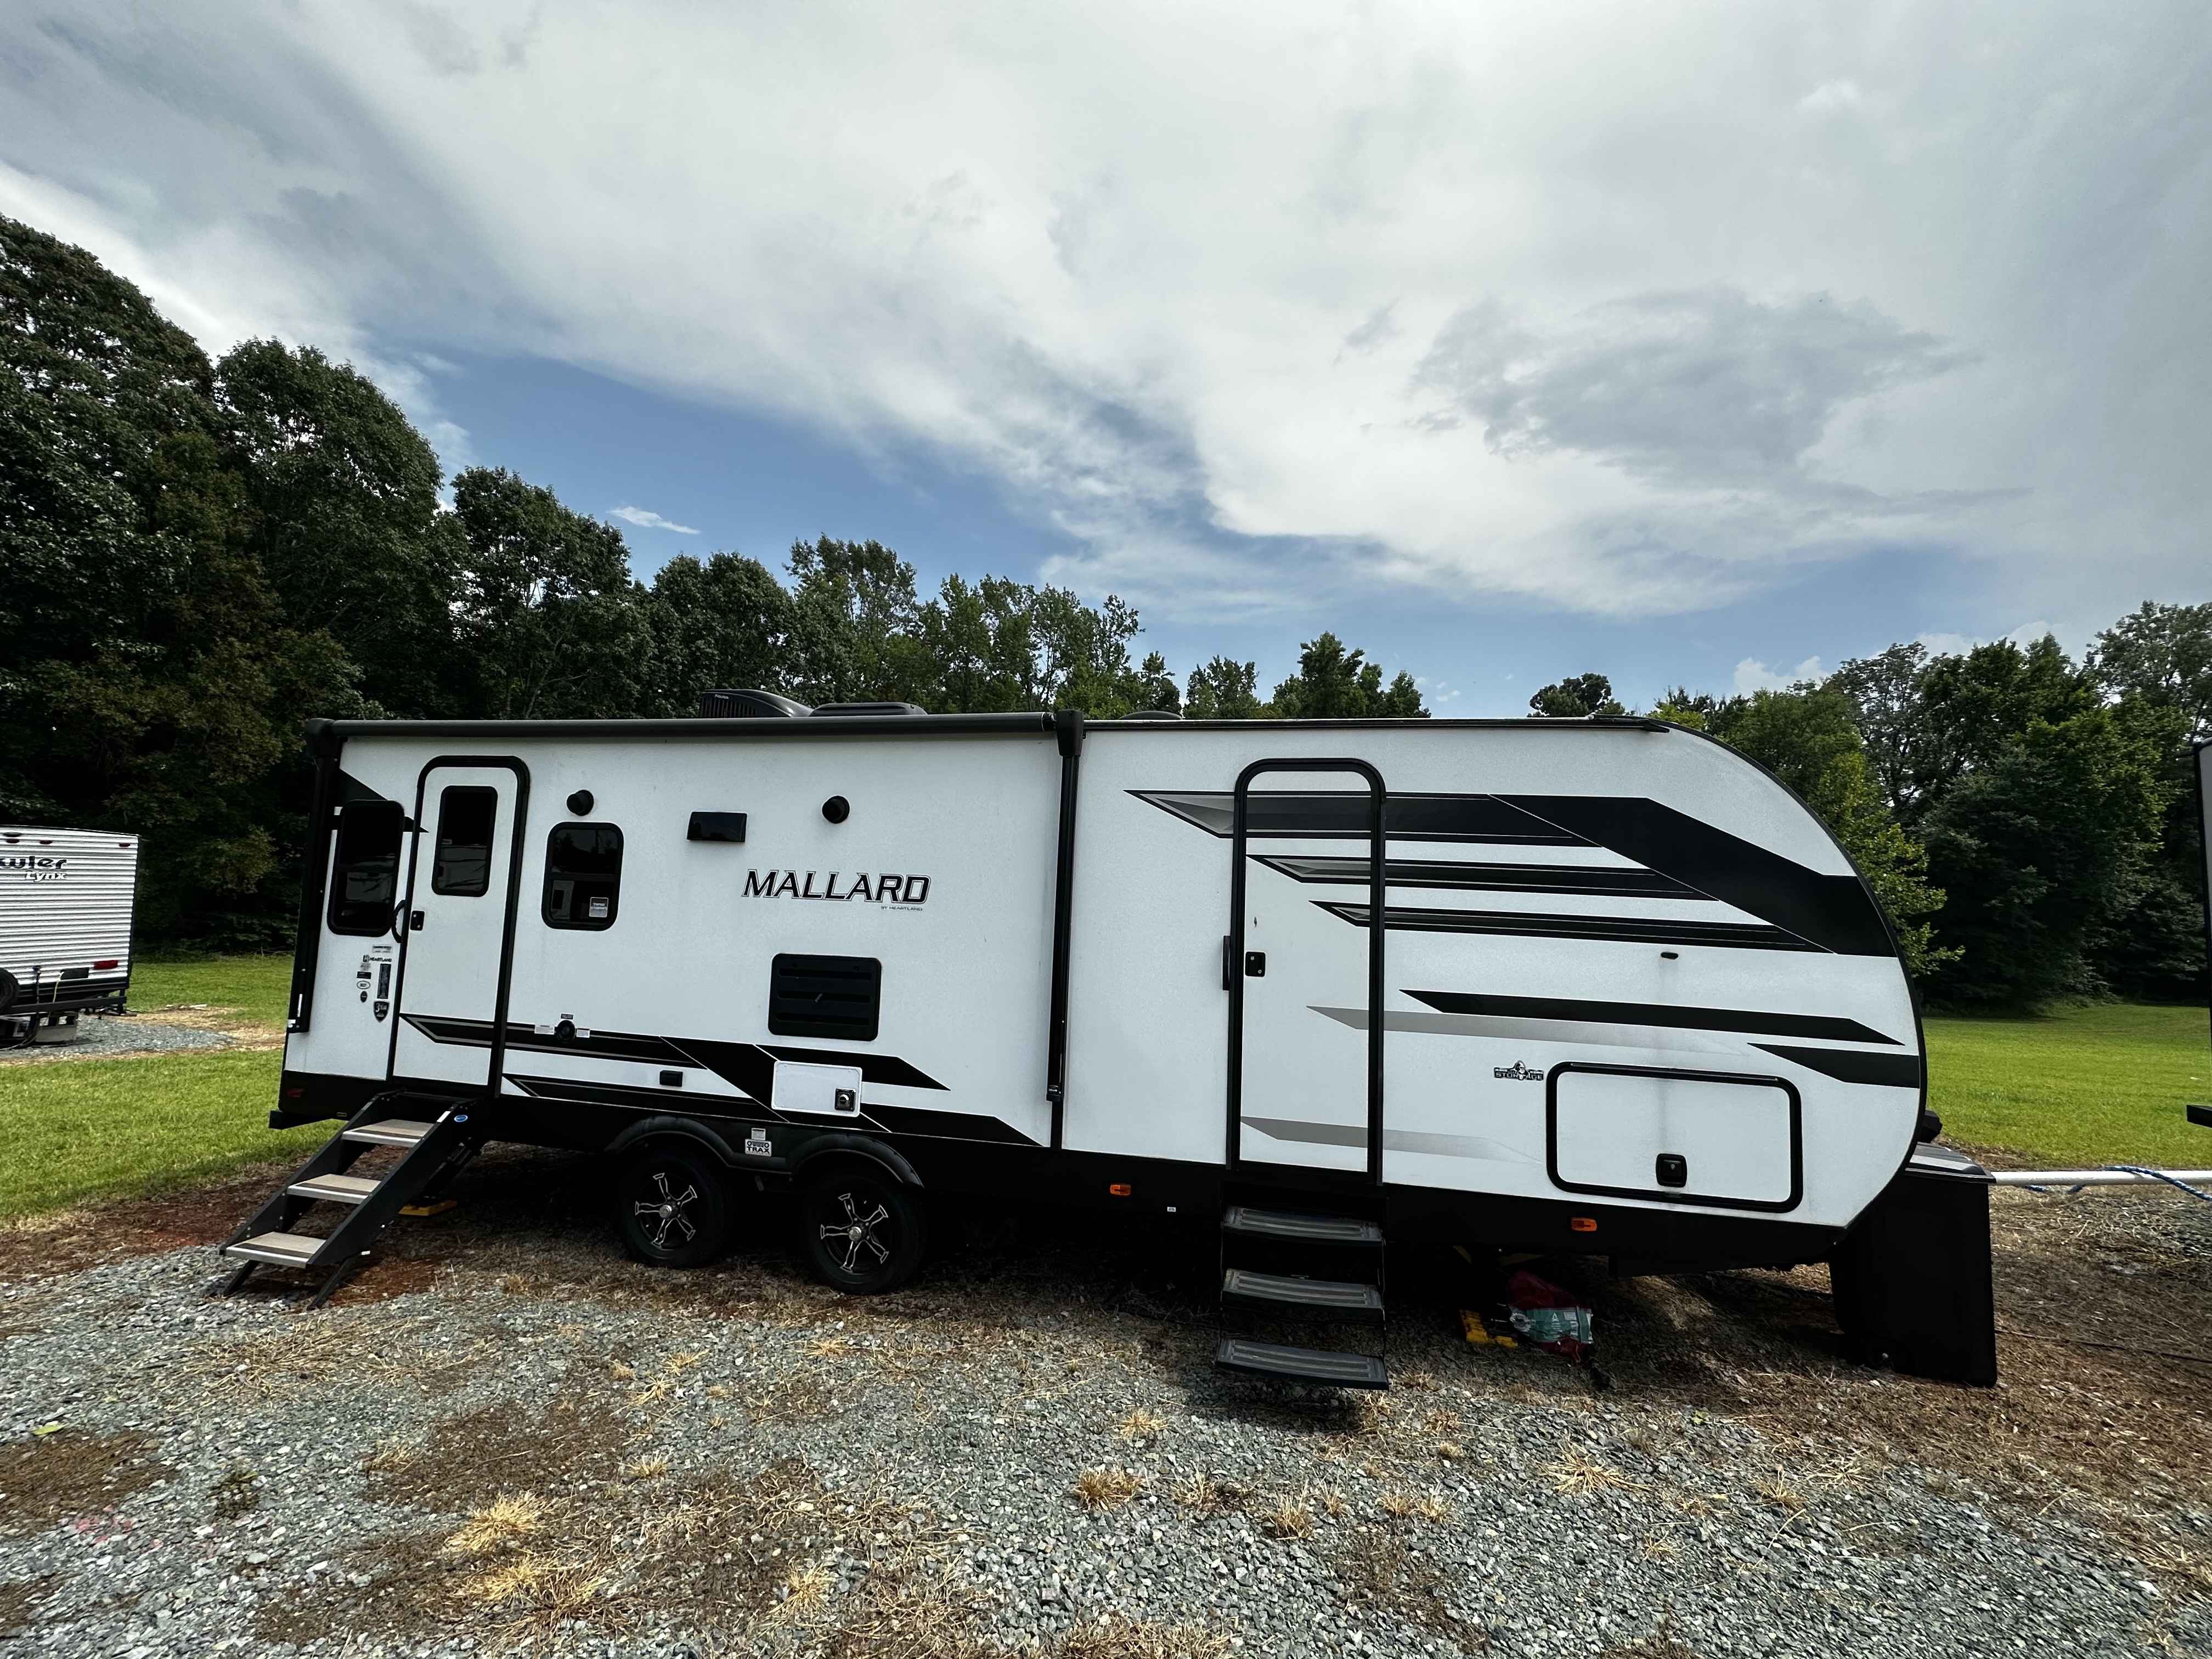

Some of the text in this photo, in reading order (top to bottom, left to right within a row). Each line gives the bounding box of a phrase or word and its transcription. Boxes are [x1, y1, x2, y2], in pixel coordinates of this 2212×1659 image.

[25, 871, 66, 882] Lynx
[741, 868, 931, 904] MALLARD
[747, 1146, 770, 1155] TRAX
